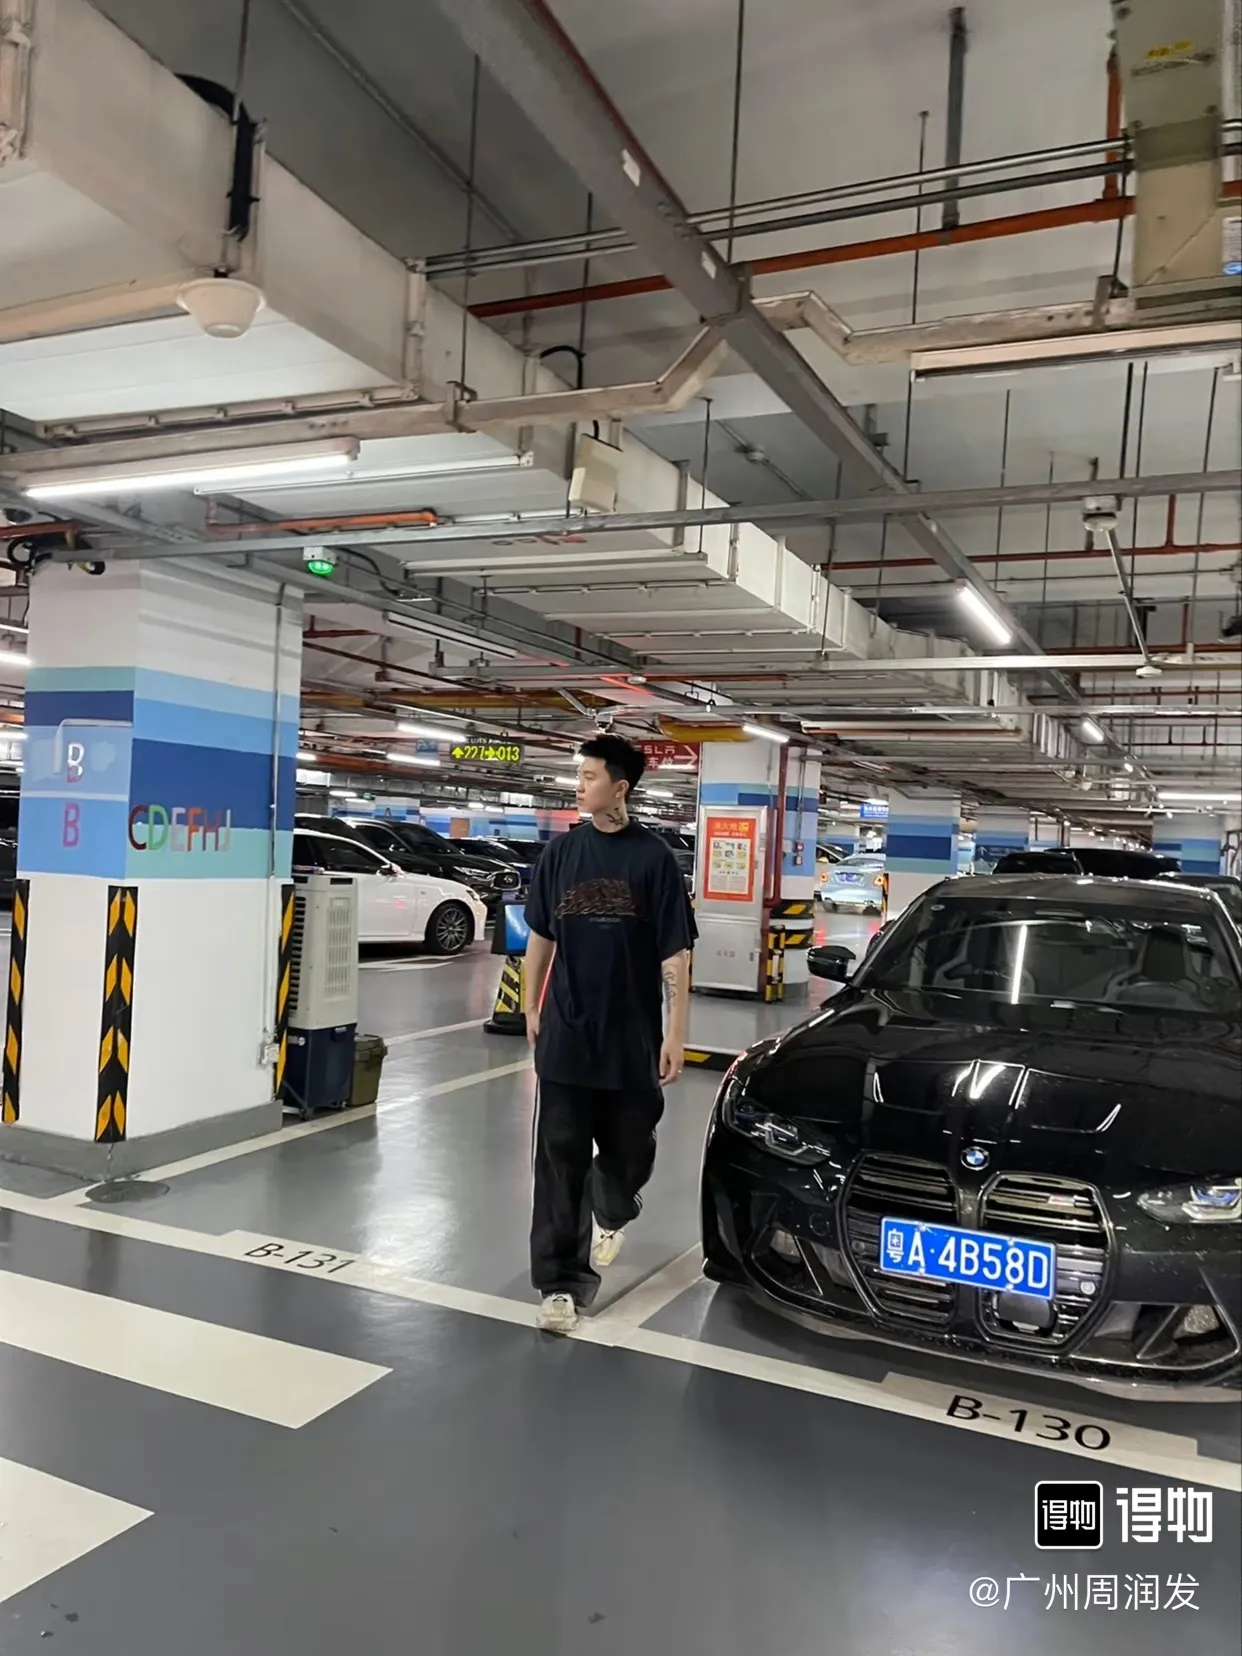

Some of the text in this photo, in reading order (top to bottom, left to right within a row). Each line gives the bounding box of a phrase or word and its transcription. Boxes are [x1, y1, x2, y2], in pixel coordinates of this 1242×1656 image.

[499, 746, 520, 761] 013
[62, 802, 81, 847] B
[244, 1243, 356, 1273] B-131
[946, 1395, 1111, 1450] B-130
